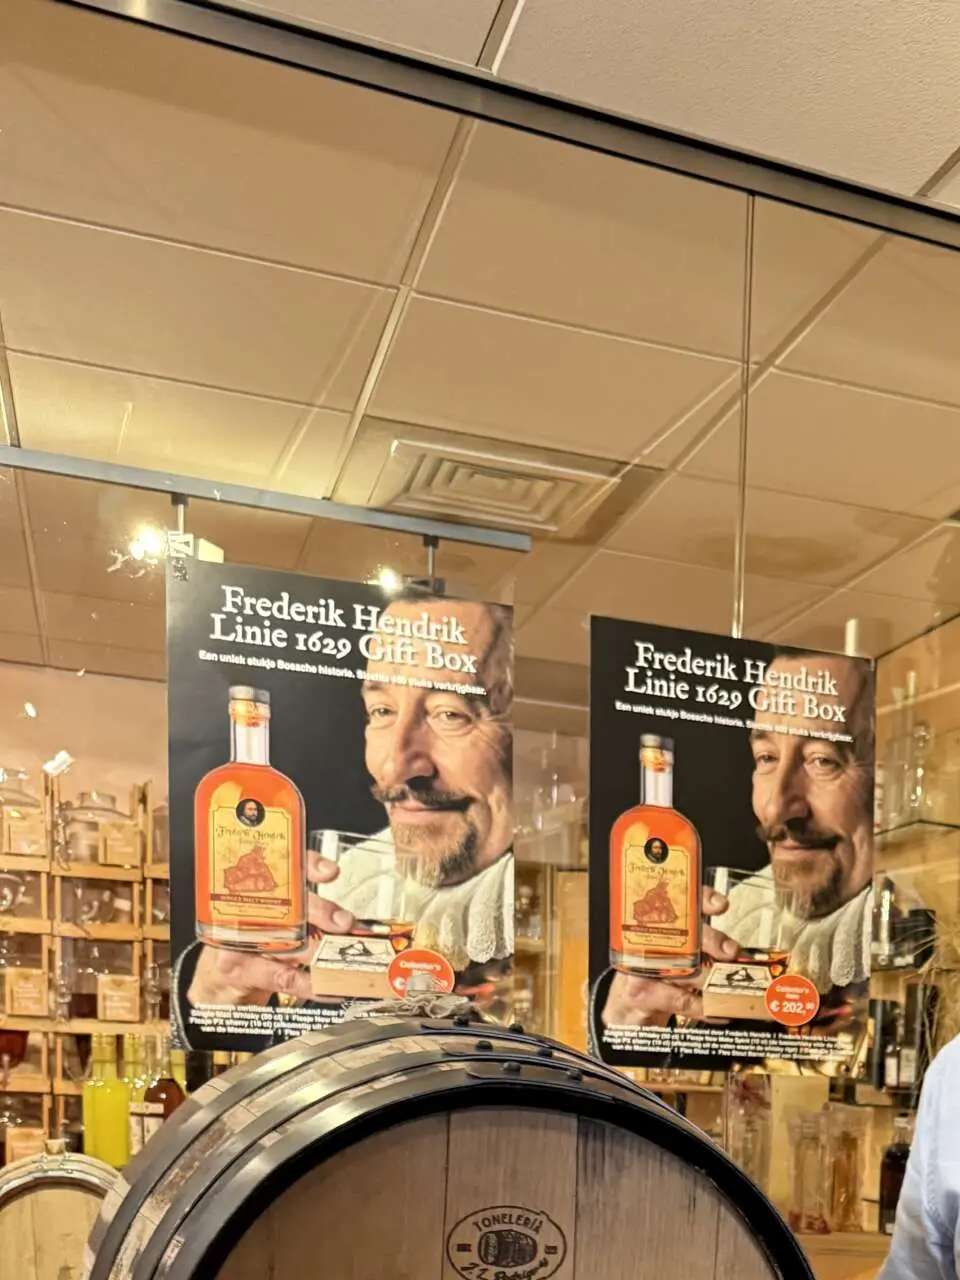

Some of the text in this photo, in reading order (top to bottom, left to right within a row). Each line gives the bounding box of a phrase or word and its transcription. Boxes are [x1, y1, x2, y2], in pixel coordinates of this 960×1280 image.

[209, 613, 477, 674] Linie 1629 Gift Box
[221, 584, 468, 645] Frederik Hendrik
[624, 666, 846, 723] Linie 1629 Gift Box
[634, 641, 838, 696] Frederik Hendrik
